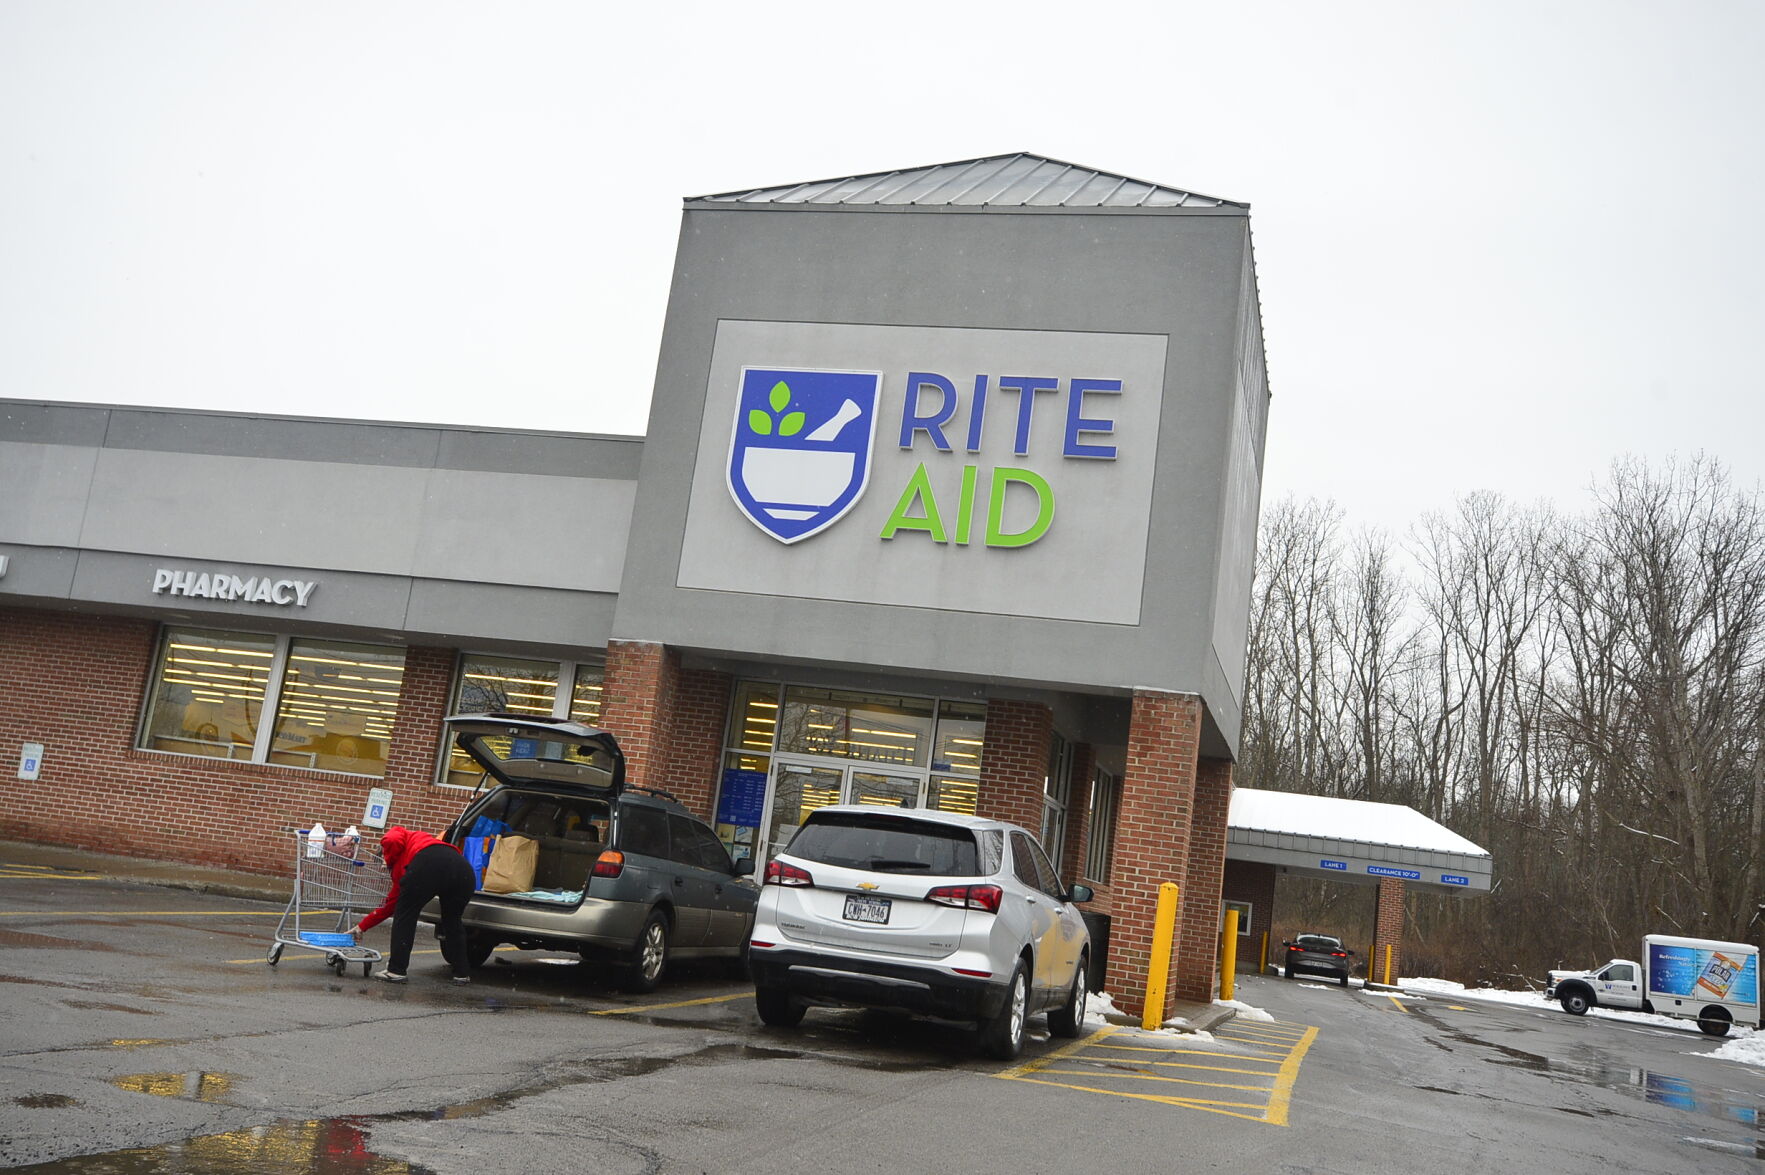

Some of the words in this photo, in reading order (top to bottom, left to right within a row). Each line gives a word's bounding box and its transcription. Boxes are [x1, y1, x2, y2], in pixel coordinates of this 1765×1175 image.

[898, 371, 1123, 460] RITE
[879, 462, 1055, 548] AID
[152, 568, 317, 607] PHARMACY
[1324, 861, 1339, 869] LANE
[1369, 867, 1401, 877] CLEARANCE
[1444, 876, 1460, 884] LANE
[1711, 965, 1731, 982] POLAR
